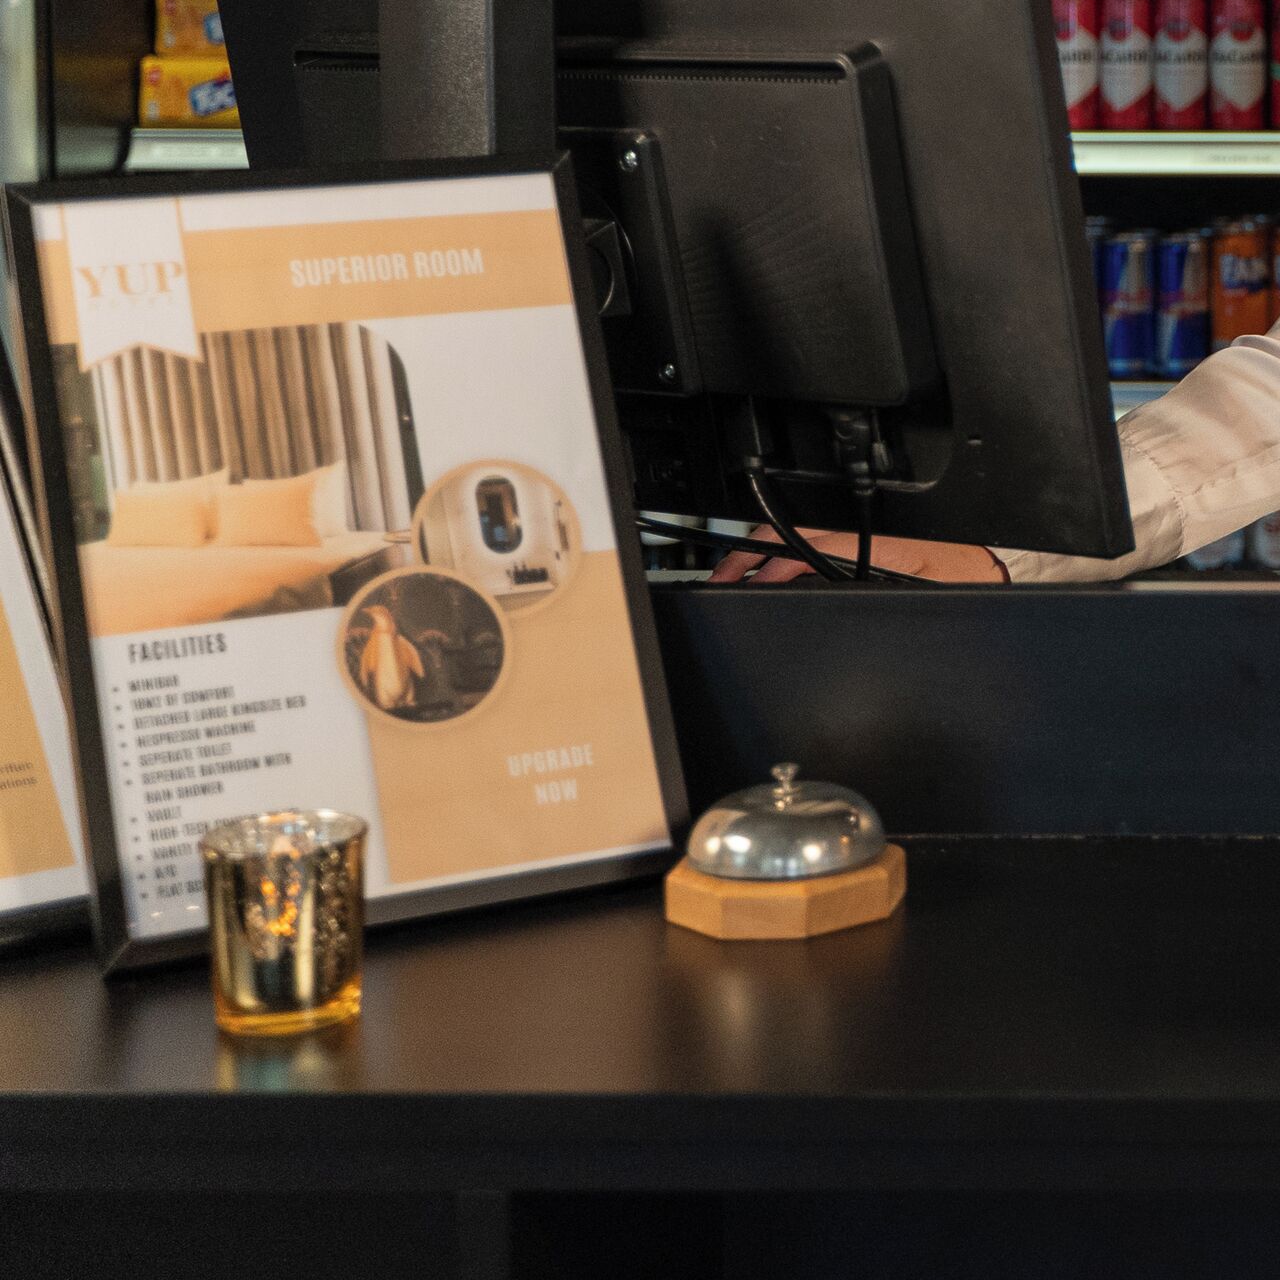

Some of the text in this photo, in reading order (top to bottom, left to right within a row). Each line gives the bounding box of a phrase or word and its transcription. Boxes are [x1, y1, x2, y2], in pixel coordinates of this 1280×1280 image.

[76, 260, 184, 299] YUP
[288, 248, 484, 289] SUPERIOR ROOM
[127, 632, 228, 664] FACILITIES
[506, 743, 594, 777] UPGRADE
[534, 778, 578, 806] NOW
